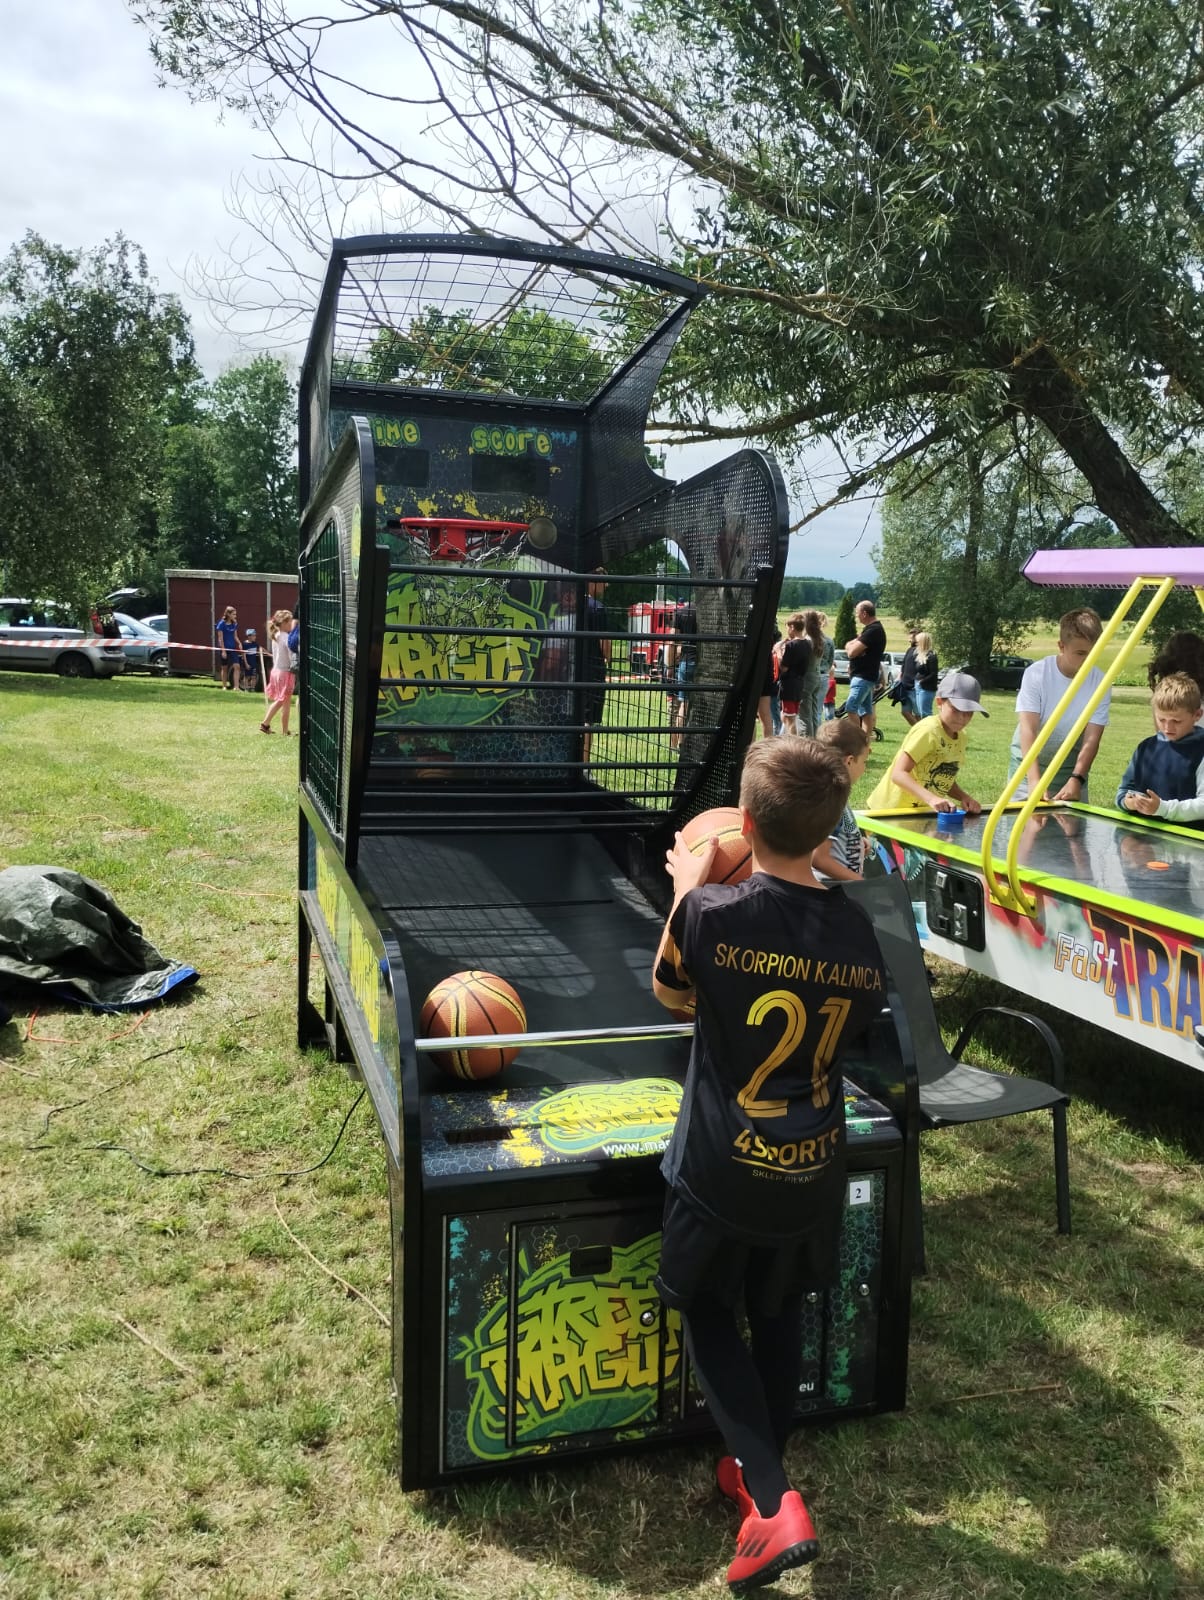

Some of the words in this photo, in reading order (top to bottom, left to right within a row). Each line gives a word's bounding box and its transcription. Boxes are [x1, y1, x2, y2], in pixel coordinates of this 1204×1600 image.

[369, 417, 420, 445] ime
[714, 943, 811, 982] SKORPION
[814, 960, 882, 992] KALNICA
[1054, 931, 1119, 997] Fast
[736, 989, 852, 1119] 21
[855, 1187, 862, 1199] 2
